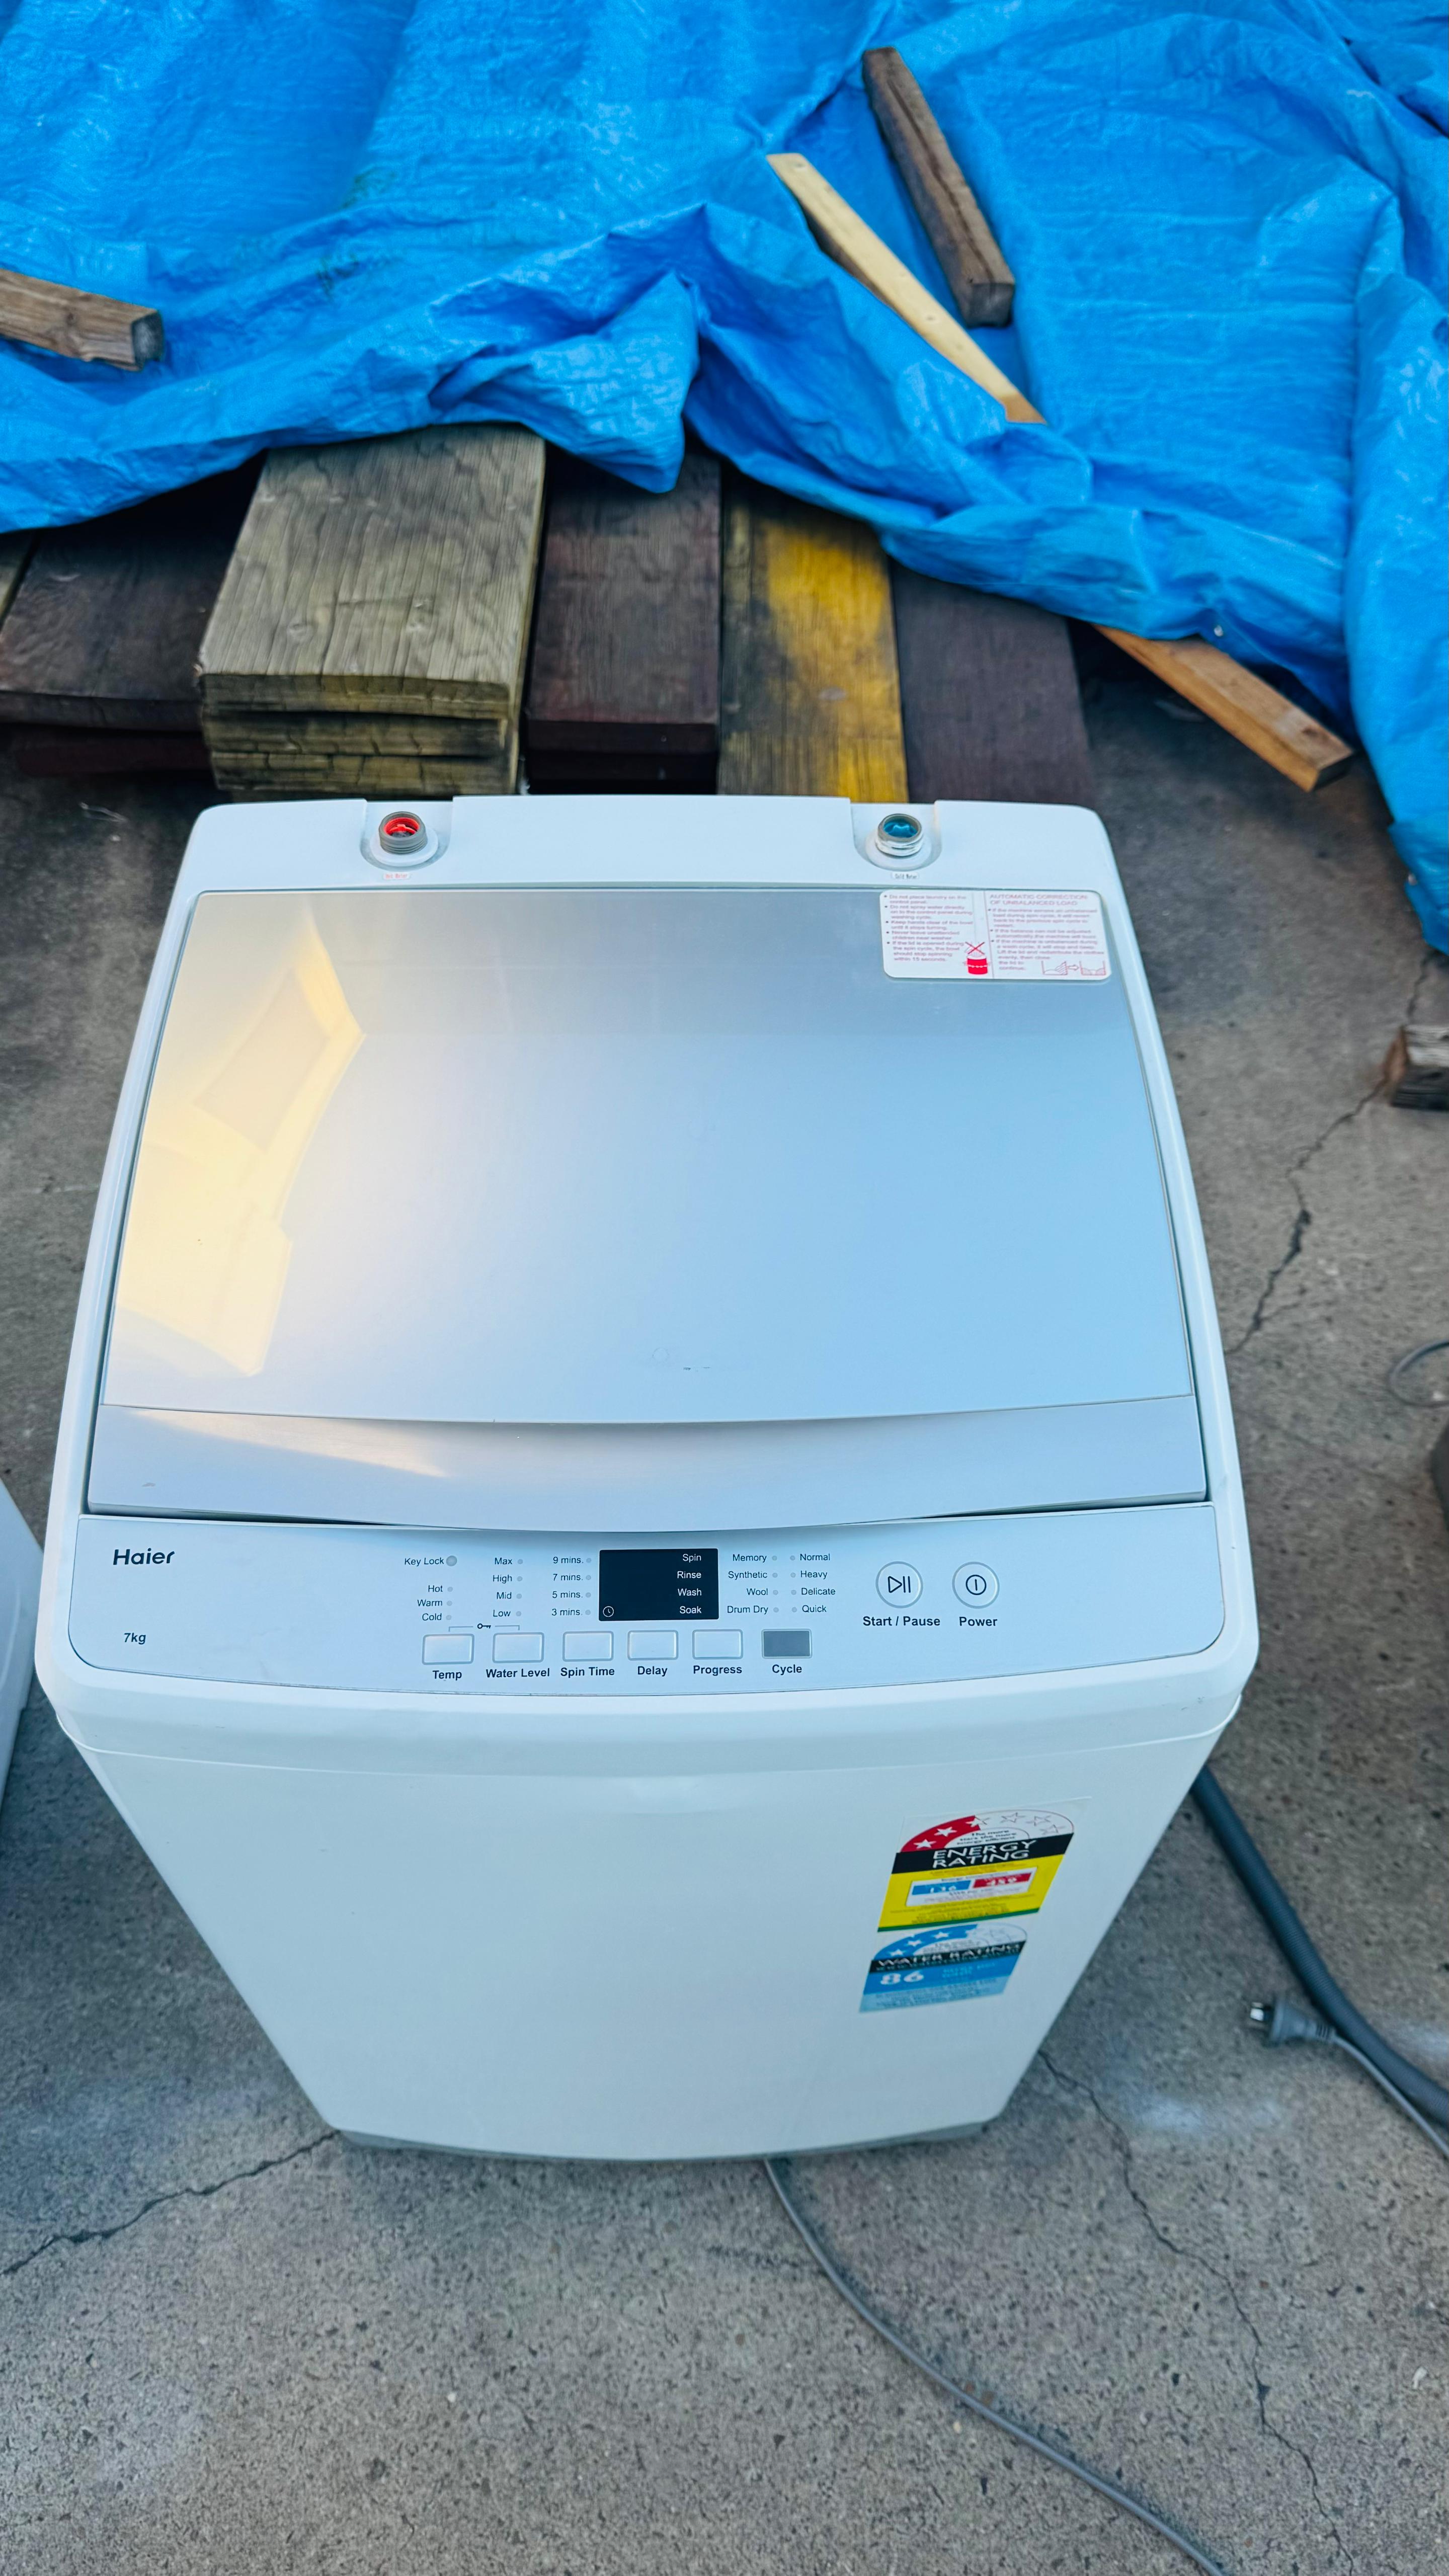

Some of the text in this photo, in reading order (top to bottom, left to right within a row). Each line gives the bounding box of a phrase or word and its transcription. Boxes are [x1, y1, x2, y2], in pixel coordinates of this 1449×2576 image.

[113, 1548, 175, 1565] Haier
[682, 1554, 701, 1563] Spin
[733, 1554, 767, 1563] Memory
[405, 1558, 421, 1566] Key
[493, 1574, 512, 1583] High
[677, 1571, 701, 1579] Rinse
[728, 1571, 768, 1580] Synthetic
[800, 1571, 828, 1580] Heavy
[801, 1587, 836, 1595] Delicate
[680, 1606, 702, 1614] Soak
[727, 1605, 768, 1615] Drum Dry
[802, 1605, 826, 1614] Quick
[863, 1616, 940, 1626] Start / Pause
[959, 1617, 998, 1627] Power
[124, 1633, 146, 1645] 7kg
[486, 1668, 550, 1678] Water Level
[560, 1667, 615, 1678] Spin Time
[637, 1666, 668, 1676] Delay
[693, 1665, 742, 1676] Progress
[772, 1664, 802, 1675] Cycle
[433, 1670, 462, 1680] Temp
[933, 1840, 1036, 1859] ENERGY
[933, 1849, 1030, 1869] RATING
[878, 1953, 942, 1966] WATER
[880, 1971, 924, 1985] 86
